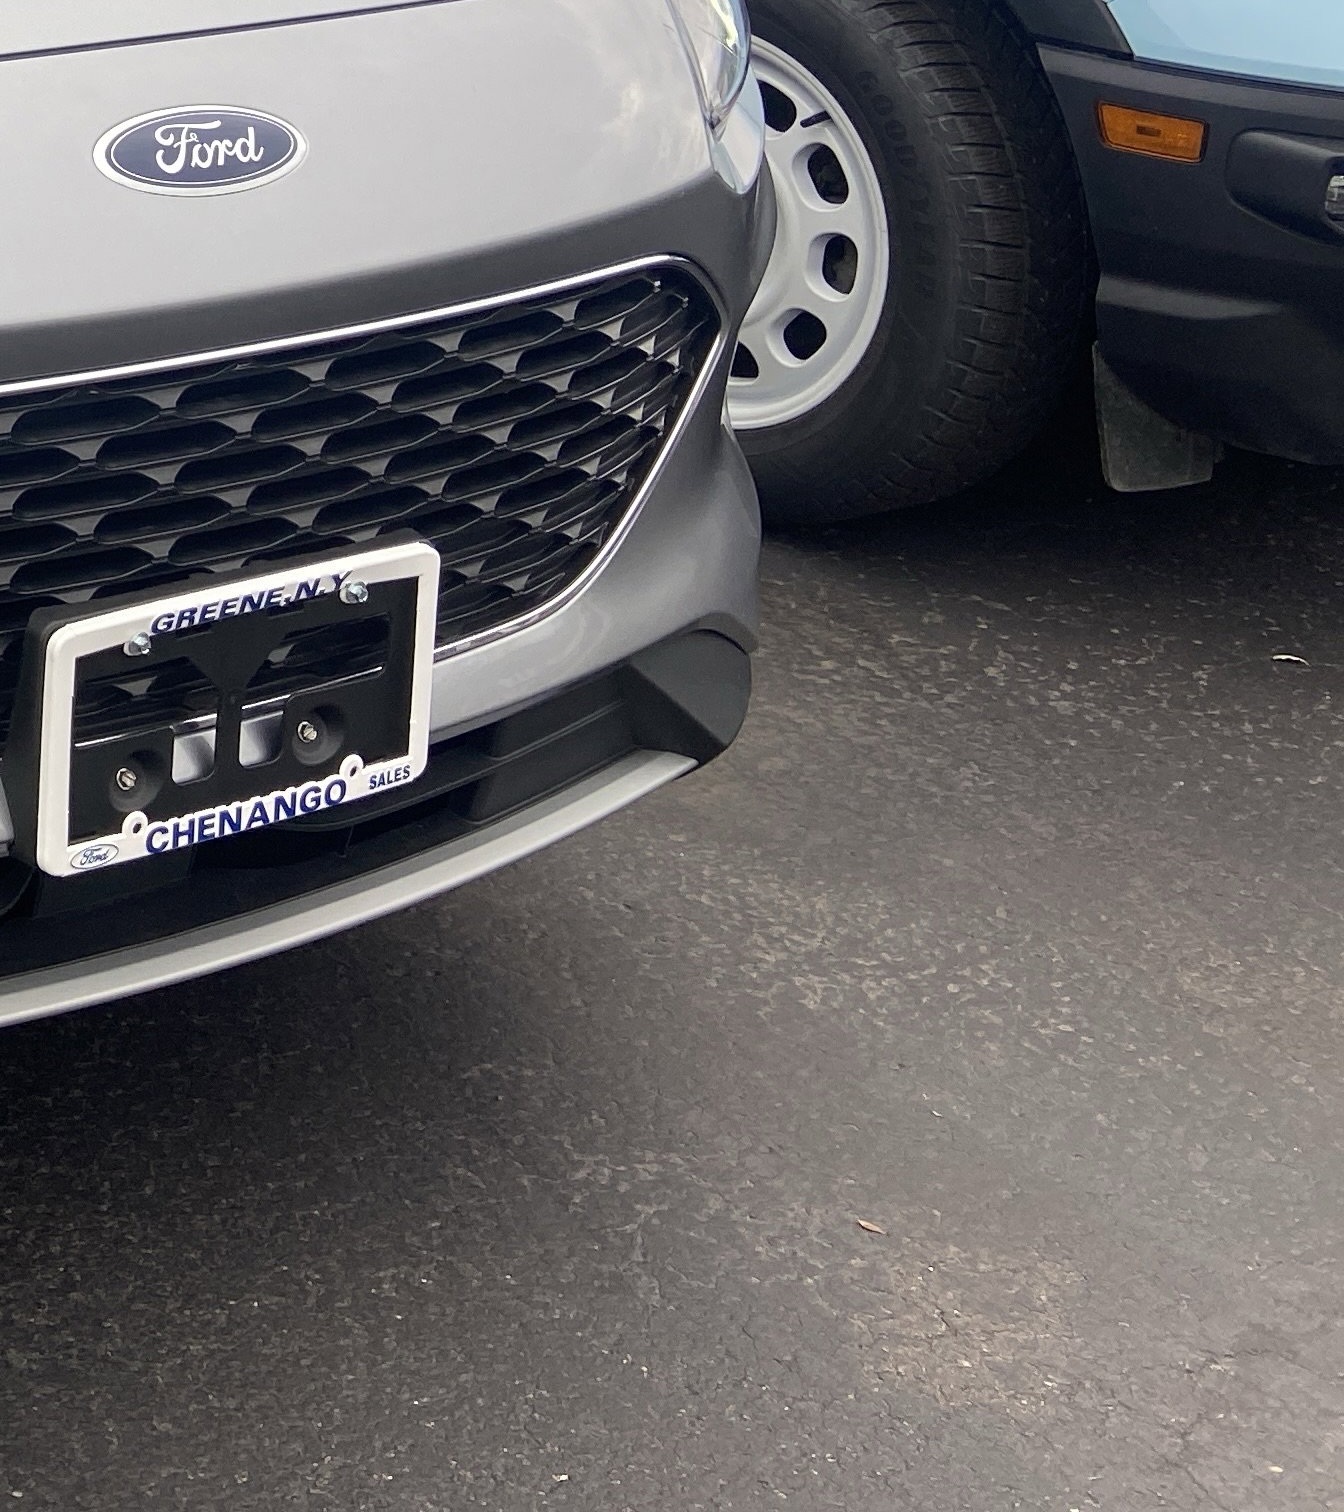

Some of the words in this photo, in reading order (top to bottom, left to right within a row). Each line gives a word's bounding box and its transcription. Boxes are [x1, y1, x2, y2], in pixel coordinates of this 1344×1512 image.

[154, 119, 265, 174] Ford
[145, 778, 348, 855] CHENANGO
[368, 764, 412, 790] SALES
